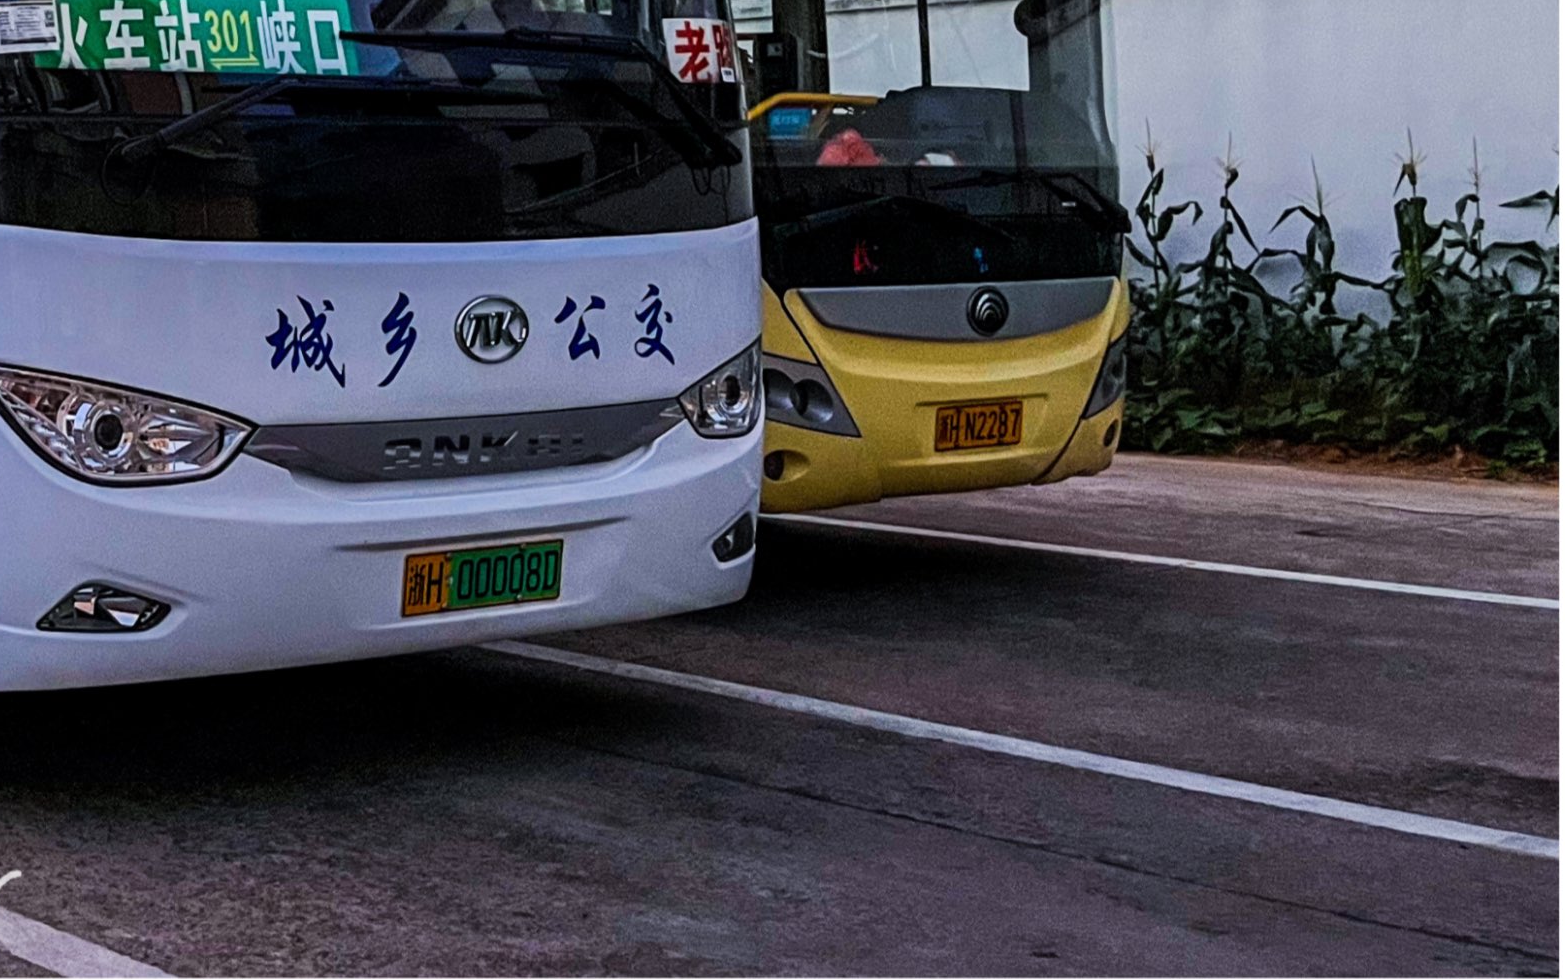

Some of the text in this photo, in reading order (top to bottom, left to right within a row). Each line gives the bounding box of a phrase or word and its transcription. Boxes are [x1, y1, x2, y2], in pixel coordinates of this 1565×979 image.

[204, 9, 256, 53] 301
[265, 283, 676, 388] 城乡 公交
